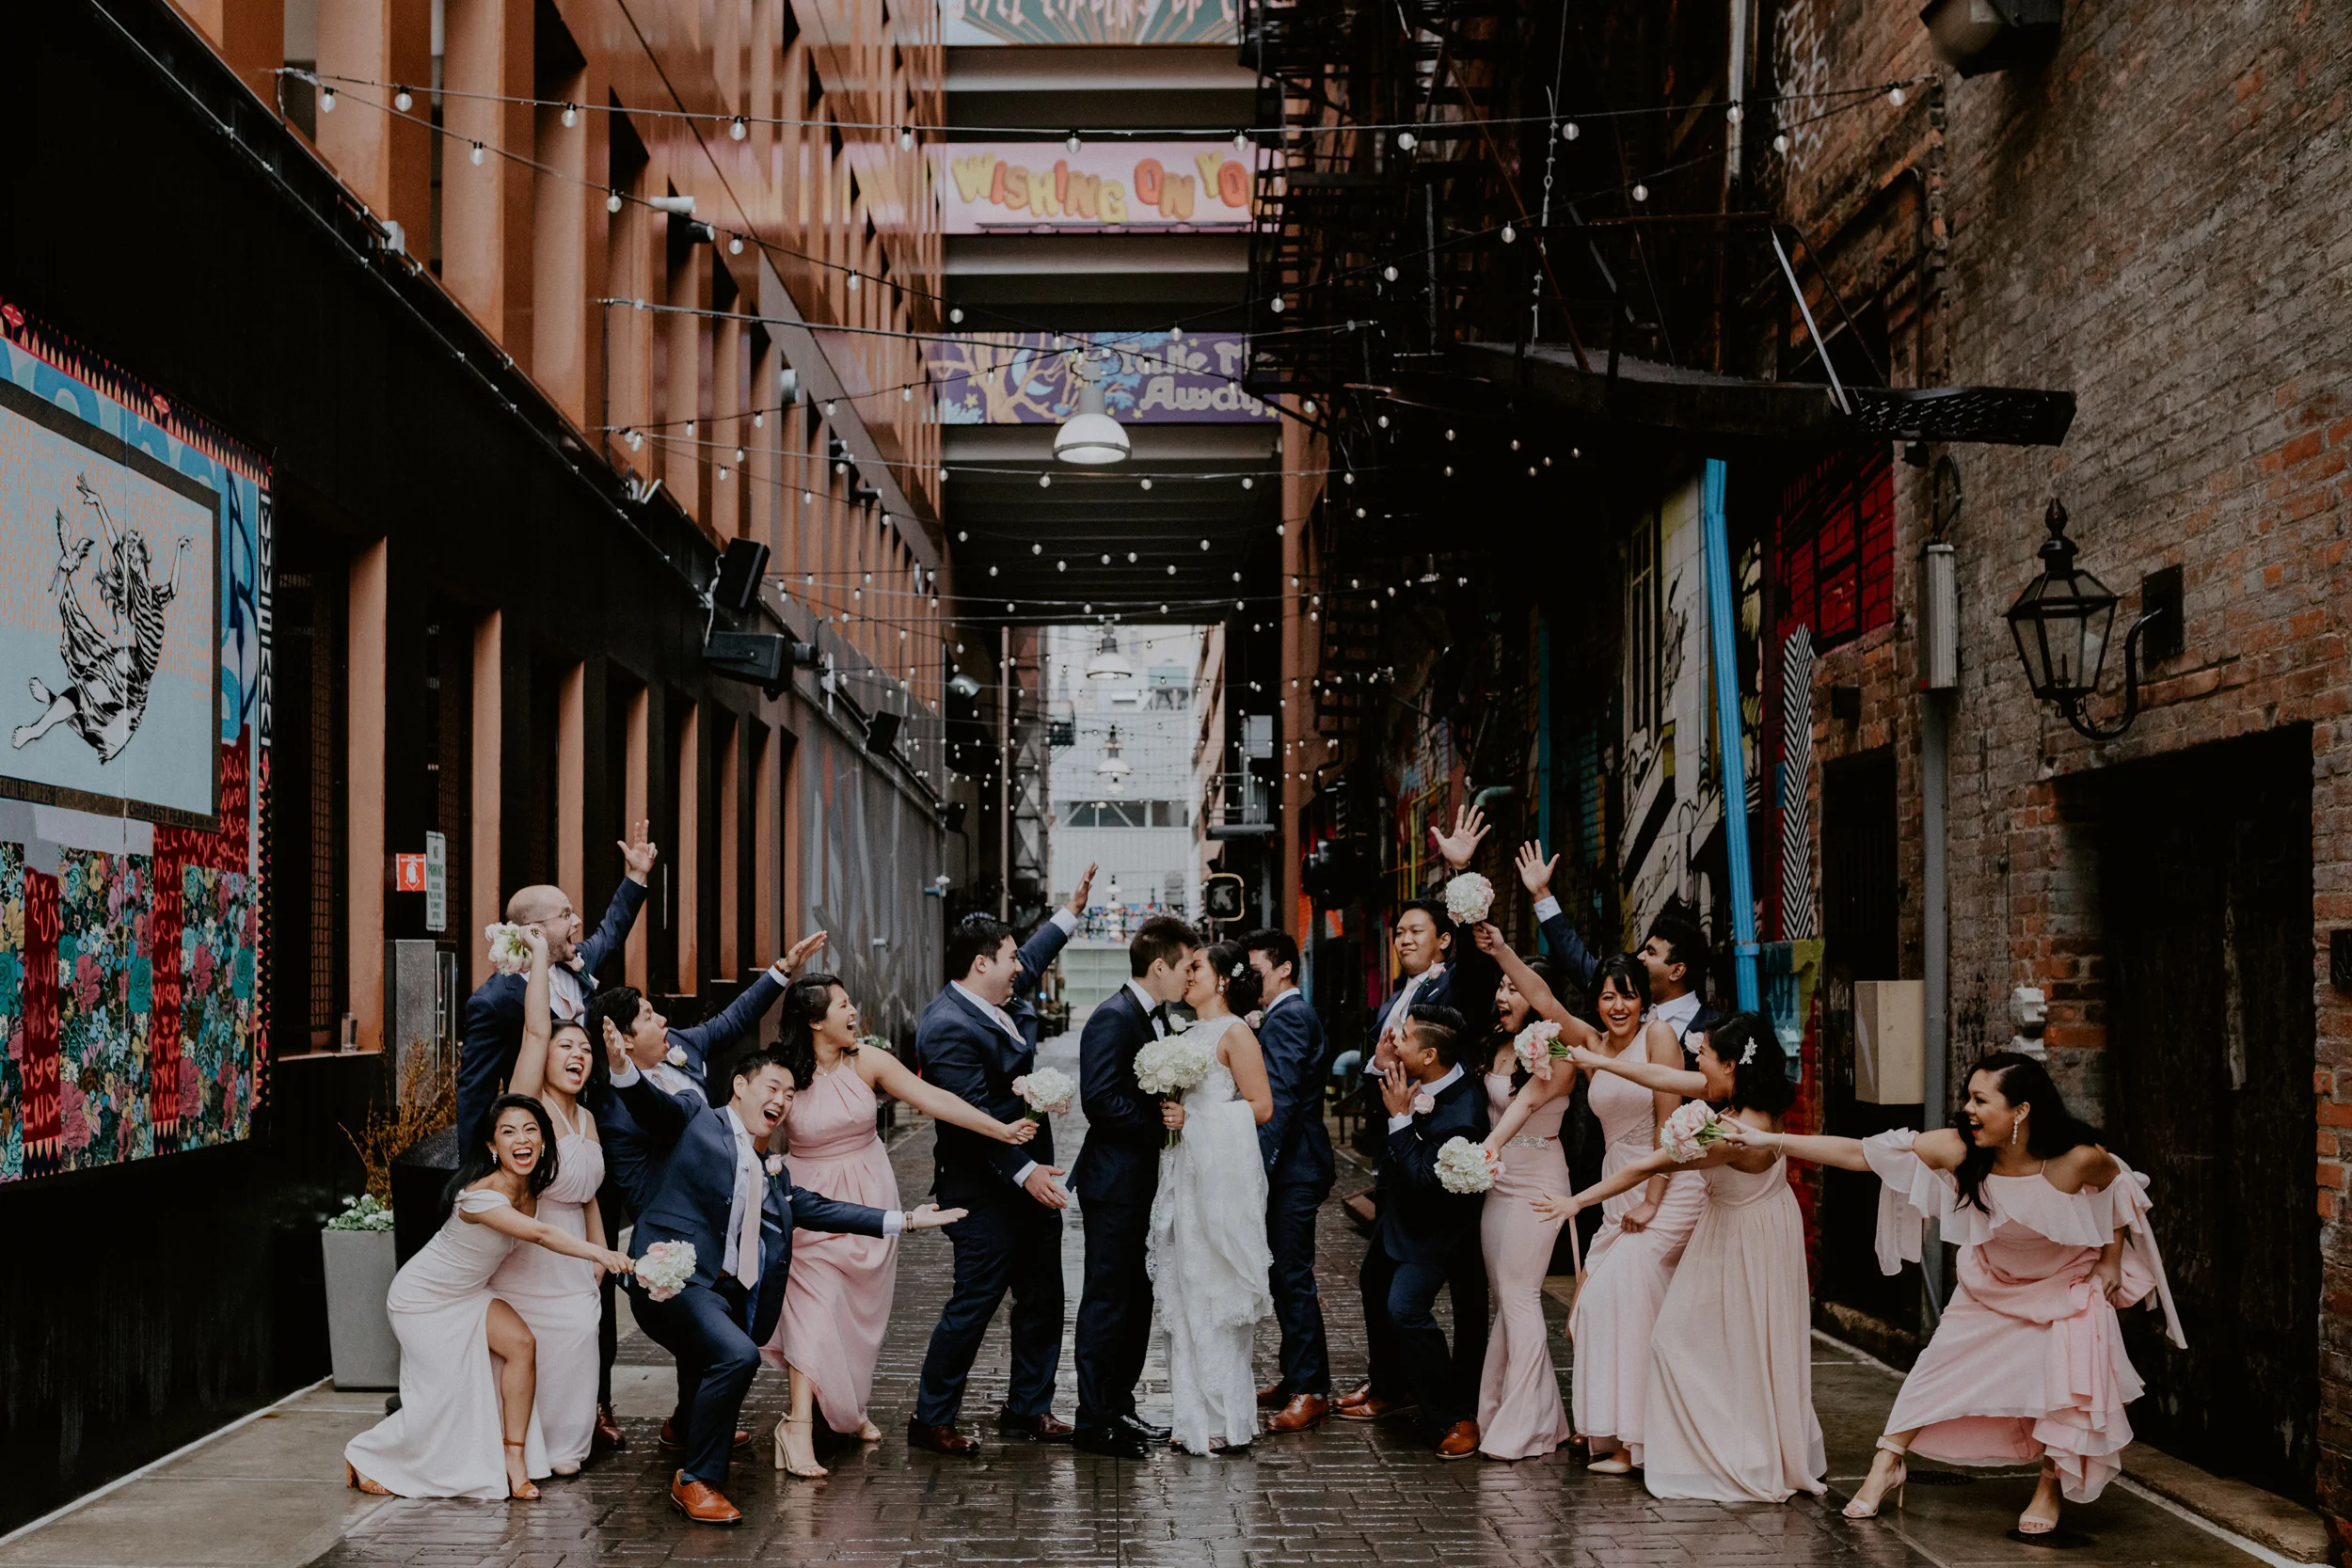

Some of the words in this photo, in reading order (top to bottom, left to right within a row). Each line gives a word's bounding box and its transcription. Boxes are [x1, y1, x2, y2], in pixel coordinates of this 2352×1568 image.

[950, 151, 1126, 223] WISHING
[1134, 158, 1195, 219] ON
[1138, 375, 1263, 417] Away
